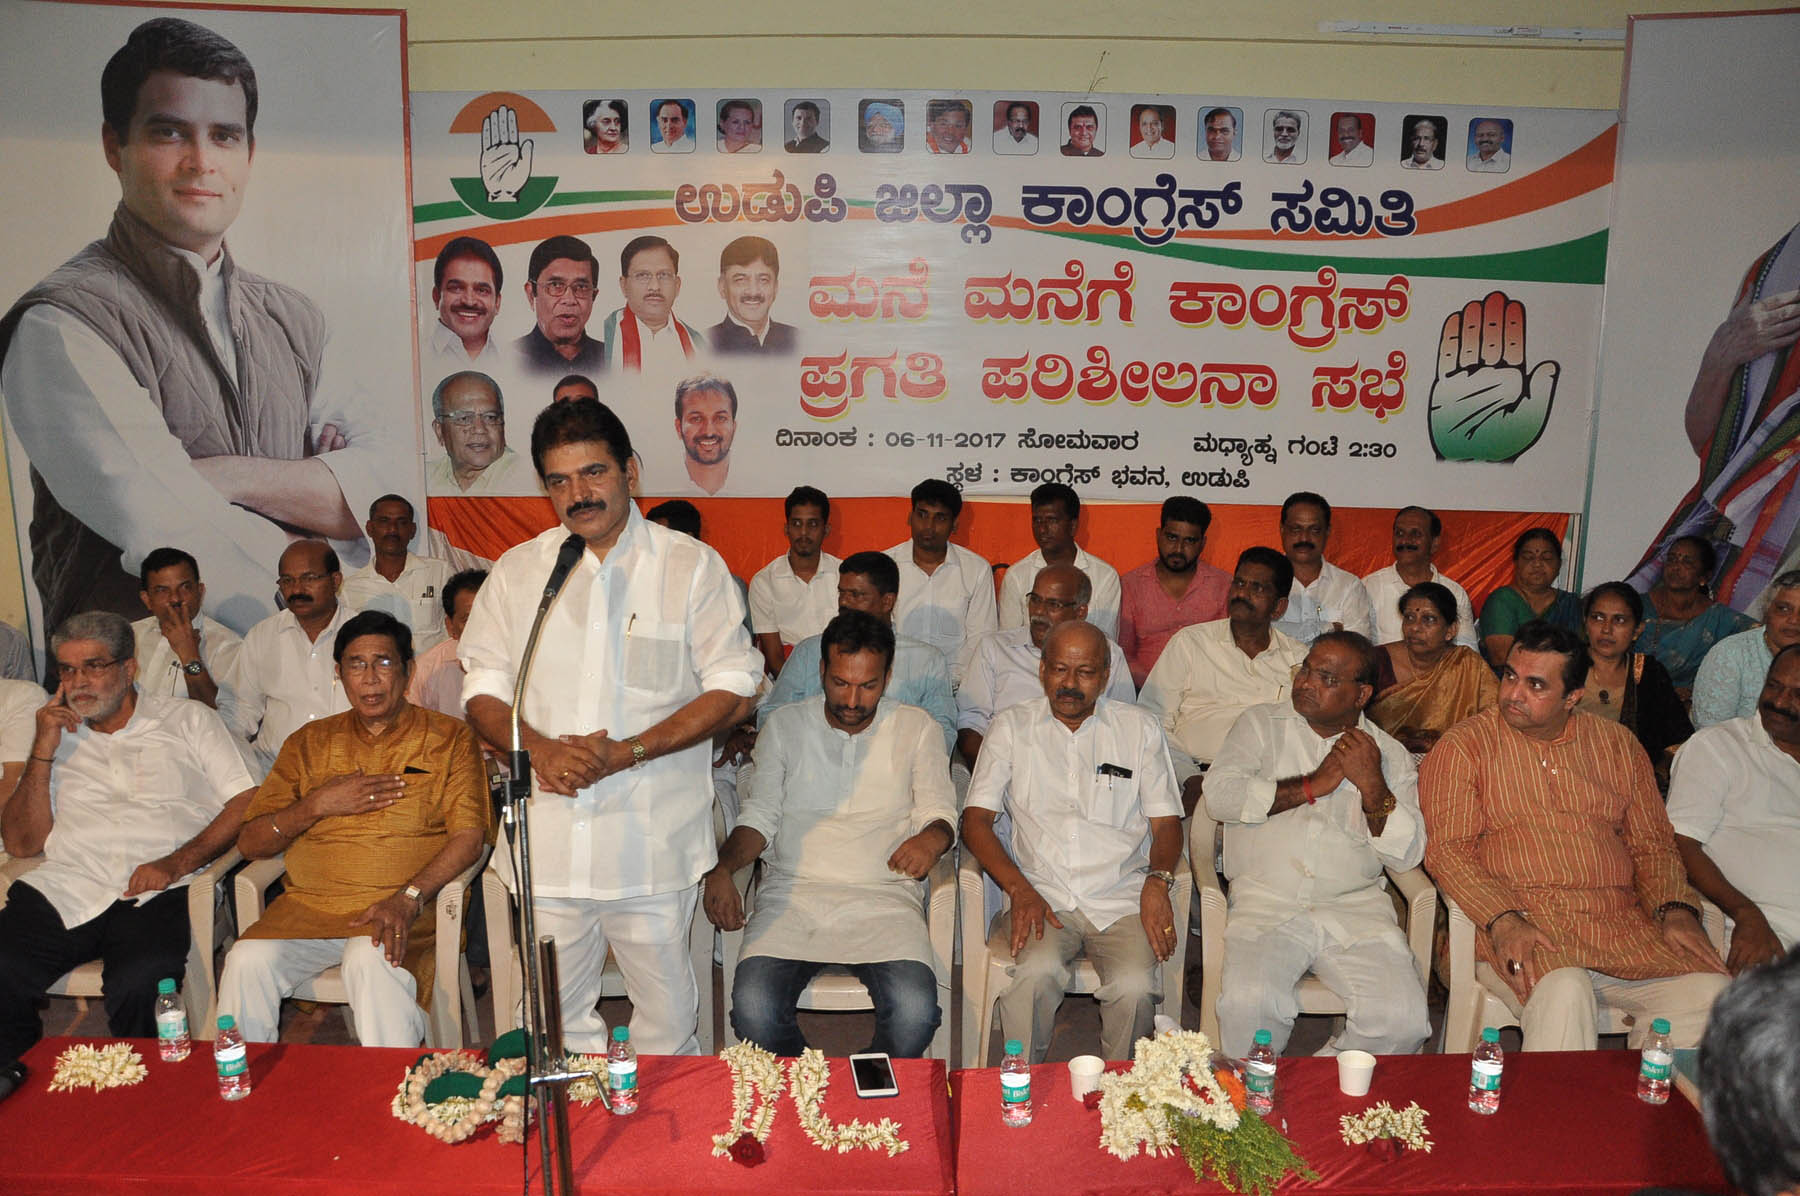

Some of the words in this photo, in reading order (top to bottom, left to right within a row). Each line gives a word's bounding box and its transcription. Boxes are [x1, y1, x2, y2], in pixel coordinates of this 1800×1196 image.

[674, 168, 848, 223] ಉಡುಪಿ
[874, 183, 993, 245] ಜಿಲ್ಲಾ
[1021, 173, 1243, 246] ಕಾಂಗ್ರೆಸ್
[1270, 179, 1417, 238] ಸಮಿತಿ
[808, 256, 932, 322] ಮನೆ
[963, 258, 1135, 324] ಮನೆಗೆ
[1168, 266, 1411, 350] ಕಾಂಗ್ರೆಸ್
[799, 347, 949, 420] ಪ್ರಗತಿ
[981, 344, 1279, 408] ಪರಿಶೀಲನಾ
[1311, 350, 1409, 420] ಸಭೆ
[775, 427, 858, 448] ದಿನಾಂಕ
[885, 431, 1007, 449] 06-11-2017
[1017, 427, 1140, 451] ಸೋಮವಾರ
[1193, 431, 1278, 466] ಮಧ್ಯಾಹ್ನ
[1287, 434, 1339, 456] ಗಂಟೆ
[1348, 441, 1398, 459] 2:30
[946, 461, 983, 493] ಸ್ಥಳ
[1010, 462, 1101, 489] ಕಾಂಗ್ರೆಸ್
[1111, 466, 1171, 489] ಭವನ,
[1181, 466, 1251, 489] ಉಡುಪಿ
